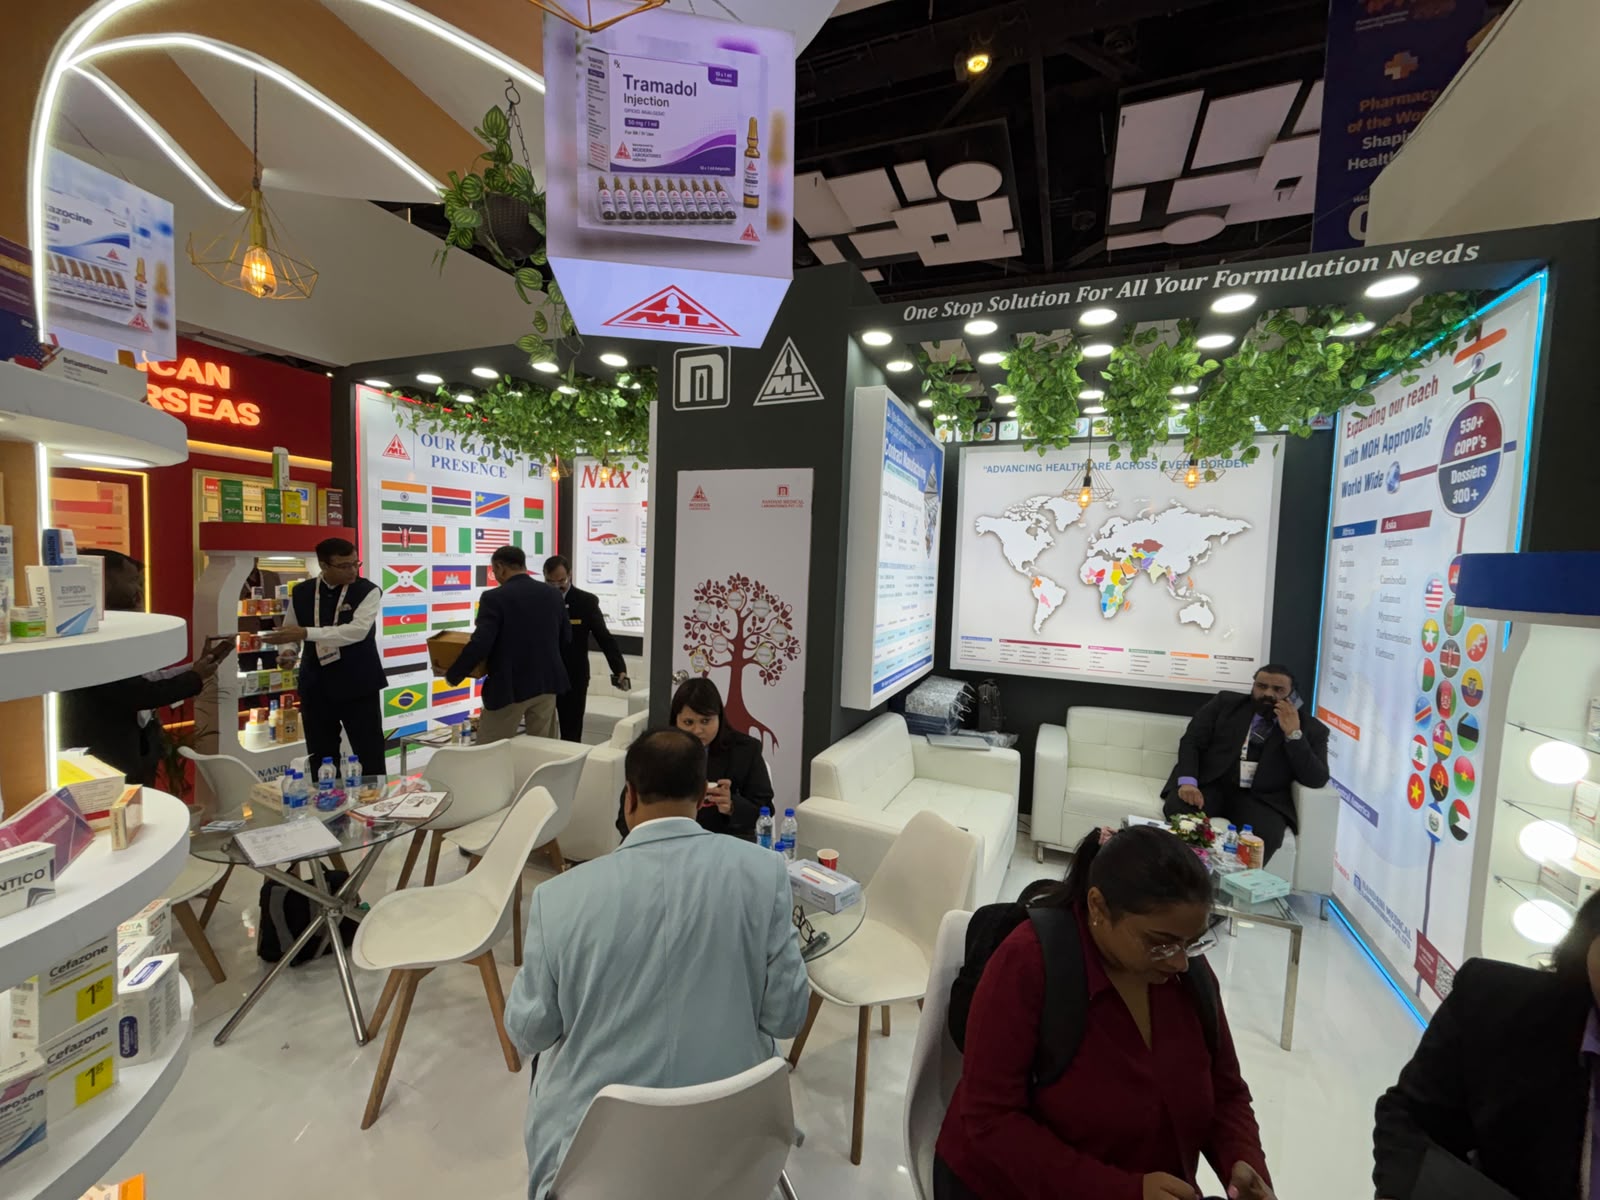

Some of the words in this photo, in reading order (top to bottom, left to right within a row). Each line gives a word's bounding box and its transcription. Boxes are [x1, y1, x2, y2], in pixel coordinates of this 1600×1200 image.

[623, 74, 697, 97] Tramadol
[623, 92, 669, 107] Injection
[1359, 89, 1441, 112] Pharmacy
[1347, 119, 1362, 133] of
[1366, 116, 1392, 131] the
[903, 305, 938, 321] One
[941, 300, 983, 319] Stop
[987, 291, 1070, 313] Solution
[1076, 285, 1113, 303] For
[1116, 279, 1147, 299] All
[1154, 275, 1208, 295] Your
[1213, 256, 1379, 289] Formulation
[1387, 243, 1480, 270] Needs
[1346, 405, 1387, 439] Expanding
[1388, 399, 1404, 418] our
[1406, 374, 1439, 408] reach
[1459, 415, 1484, 435] 550+
[420, 433, 456, 453] OUR
[1343, 446, 1359, 468] with
[1361, 436, 1380, 460] MOH
[1383, 415, 1433, 456] Approvals
[1453, 434, 1487, 456] COPP's
[431, 454, 508, 479] PRESENCE
[1046, 461, 1112, 472] HEALTHARE
[1115, 460, 1158, 471] ACROSS
[1451, 464, 1487, 484] Dossiers
[1341, 476, 1362, 499] World
[1364, 469, 1384, 493] Wide
[1452, 487, 1480, 505] 300+
[1384, 519, 1397, 530] Asia
[1380, 576, 1406, 585] Cambodia
[49, 944, 109, 978] Cefazone
[47, 1026, 109, 1065] Cefazone
